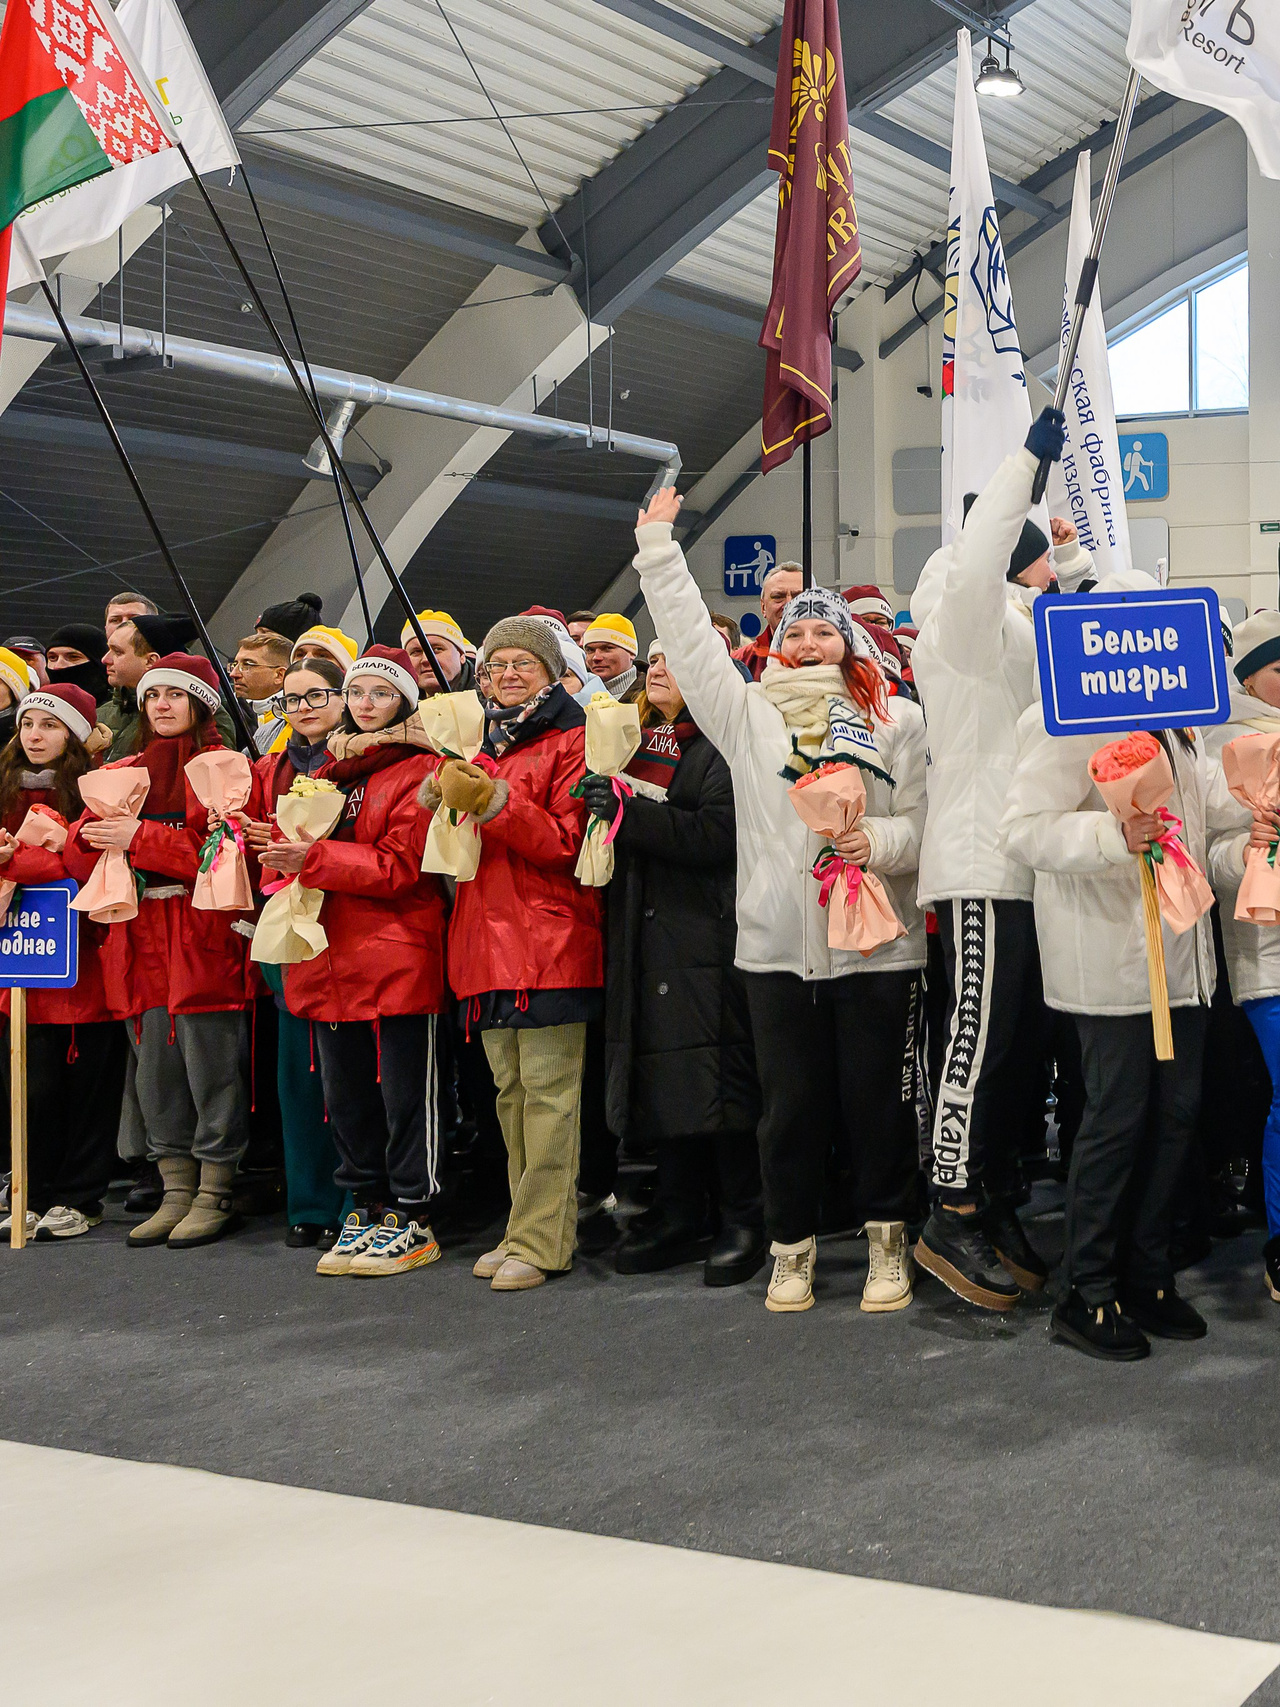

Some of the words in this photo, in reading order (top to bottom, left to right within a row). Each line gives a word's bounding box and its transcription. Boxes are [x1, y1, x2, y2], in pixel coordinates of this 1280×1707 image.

[1062, 453, 1101, 552] изделий
[1080, 432, 1116, 548] фабрика
[1081, 620, 1179, 656] Белые
[351, 661, 400, 678] БЕЛАРУСЬ
[1080, 664, 1188, 702] тигры
[1, 930, 57, 956] однае
[902, 1063, 914, 1102] 2012
